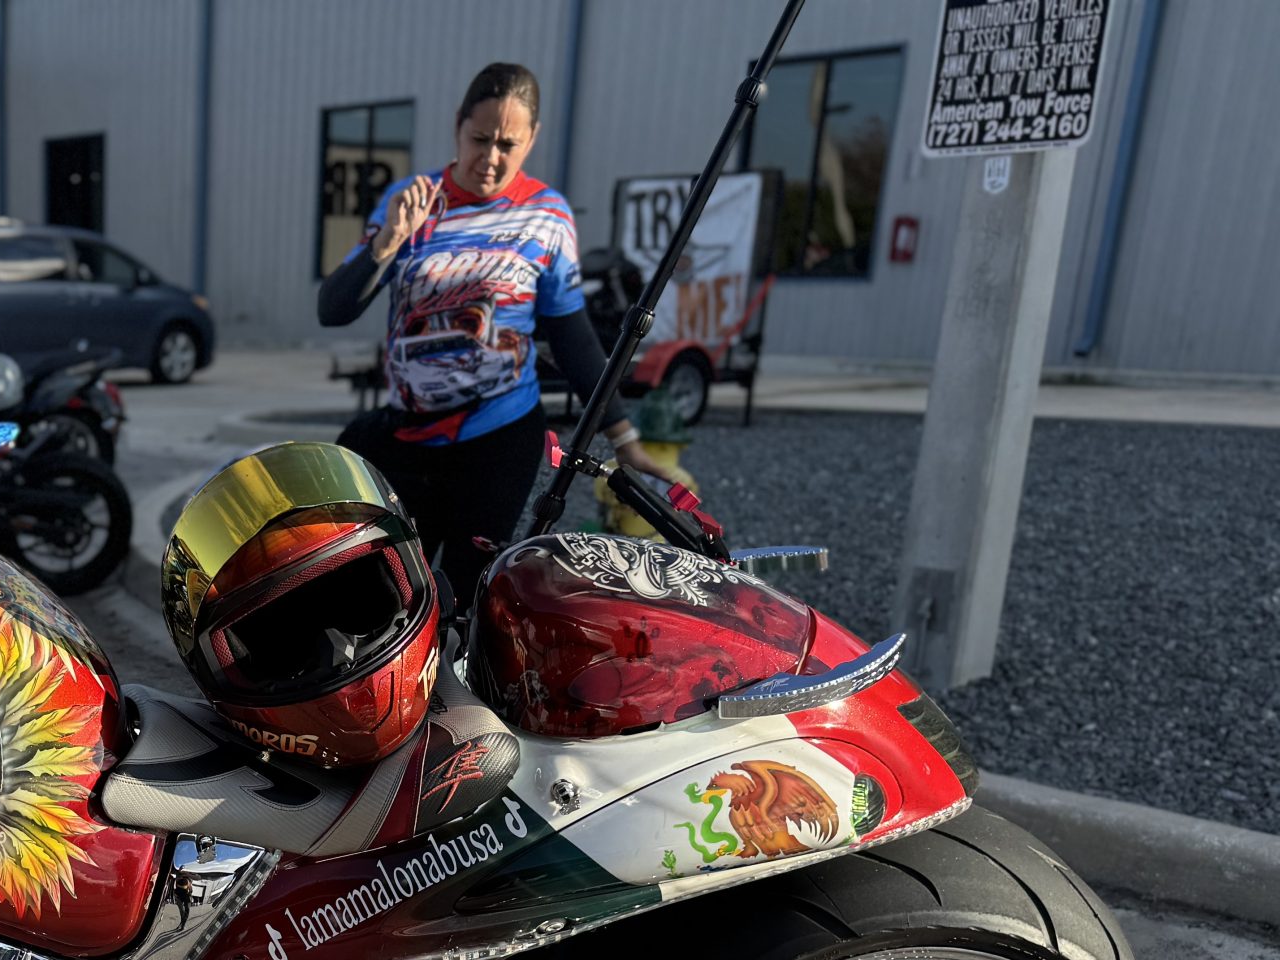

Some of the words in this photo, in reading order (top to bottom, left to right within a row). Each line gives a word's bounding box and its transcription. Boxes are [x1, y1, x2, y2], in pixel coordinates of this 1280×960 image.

[946, 0, 1039, 31] UNAUTHORIZED
[1044, 0, 1104, 19] VEHICLES
[944, 31, 961, 55] OR
[964, 26, 1011, 53] VESSELS
[1013, 22, 1038, 47] WILL
[1042, 20, 1059, 45] BE
[1062, 15, 1102, 42] TOWED
[940, 53, 971, 78] AWAY
[973, 51, 988, 75] AT
[990, 47, 1039, 74] OWNERS
[1042, 40, 1097, 68] EXPENSE
[936, 78, 953, 101] 24
[980, 74, 989, 97] A
[992, 72, 1015, 96] DAY
[1016, 70, 1025, 94] 7
[1027, 67, 1056, 94] DAYS
[1057, 66, 1068, 90] A
[931, 98, 1004, 125] American
[1009, 94, 1041, 118] Tow
[1044, 91, 1091, 116] Force
[926, 121, 979, 148] (727)
[983, 113, 1087, 143] 244-2160
[285, 822, 503, 951] lamamalonabusa
